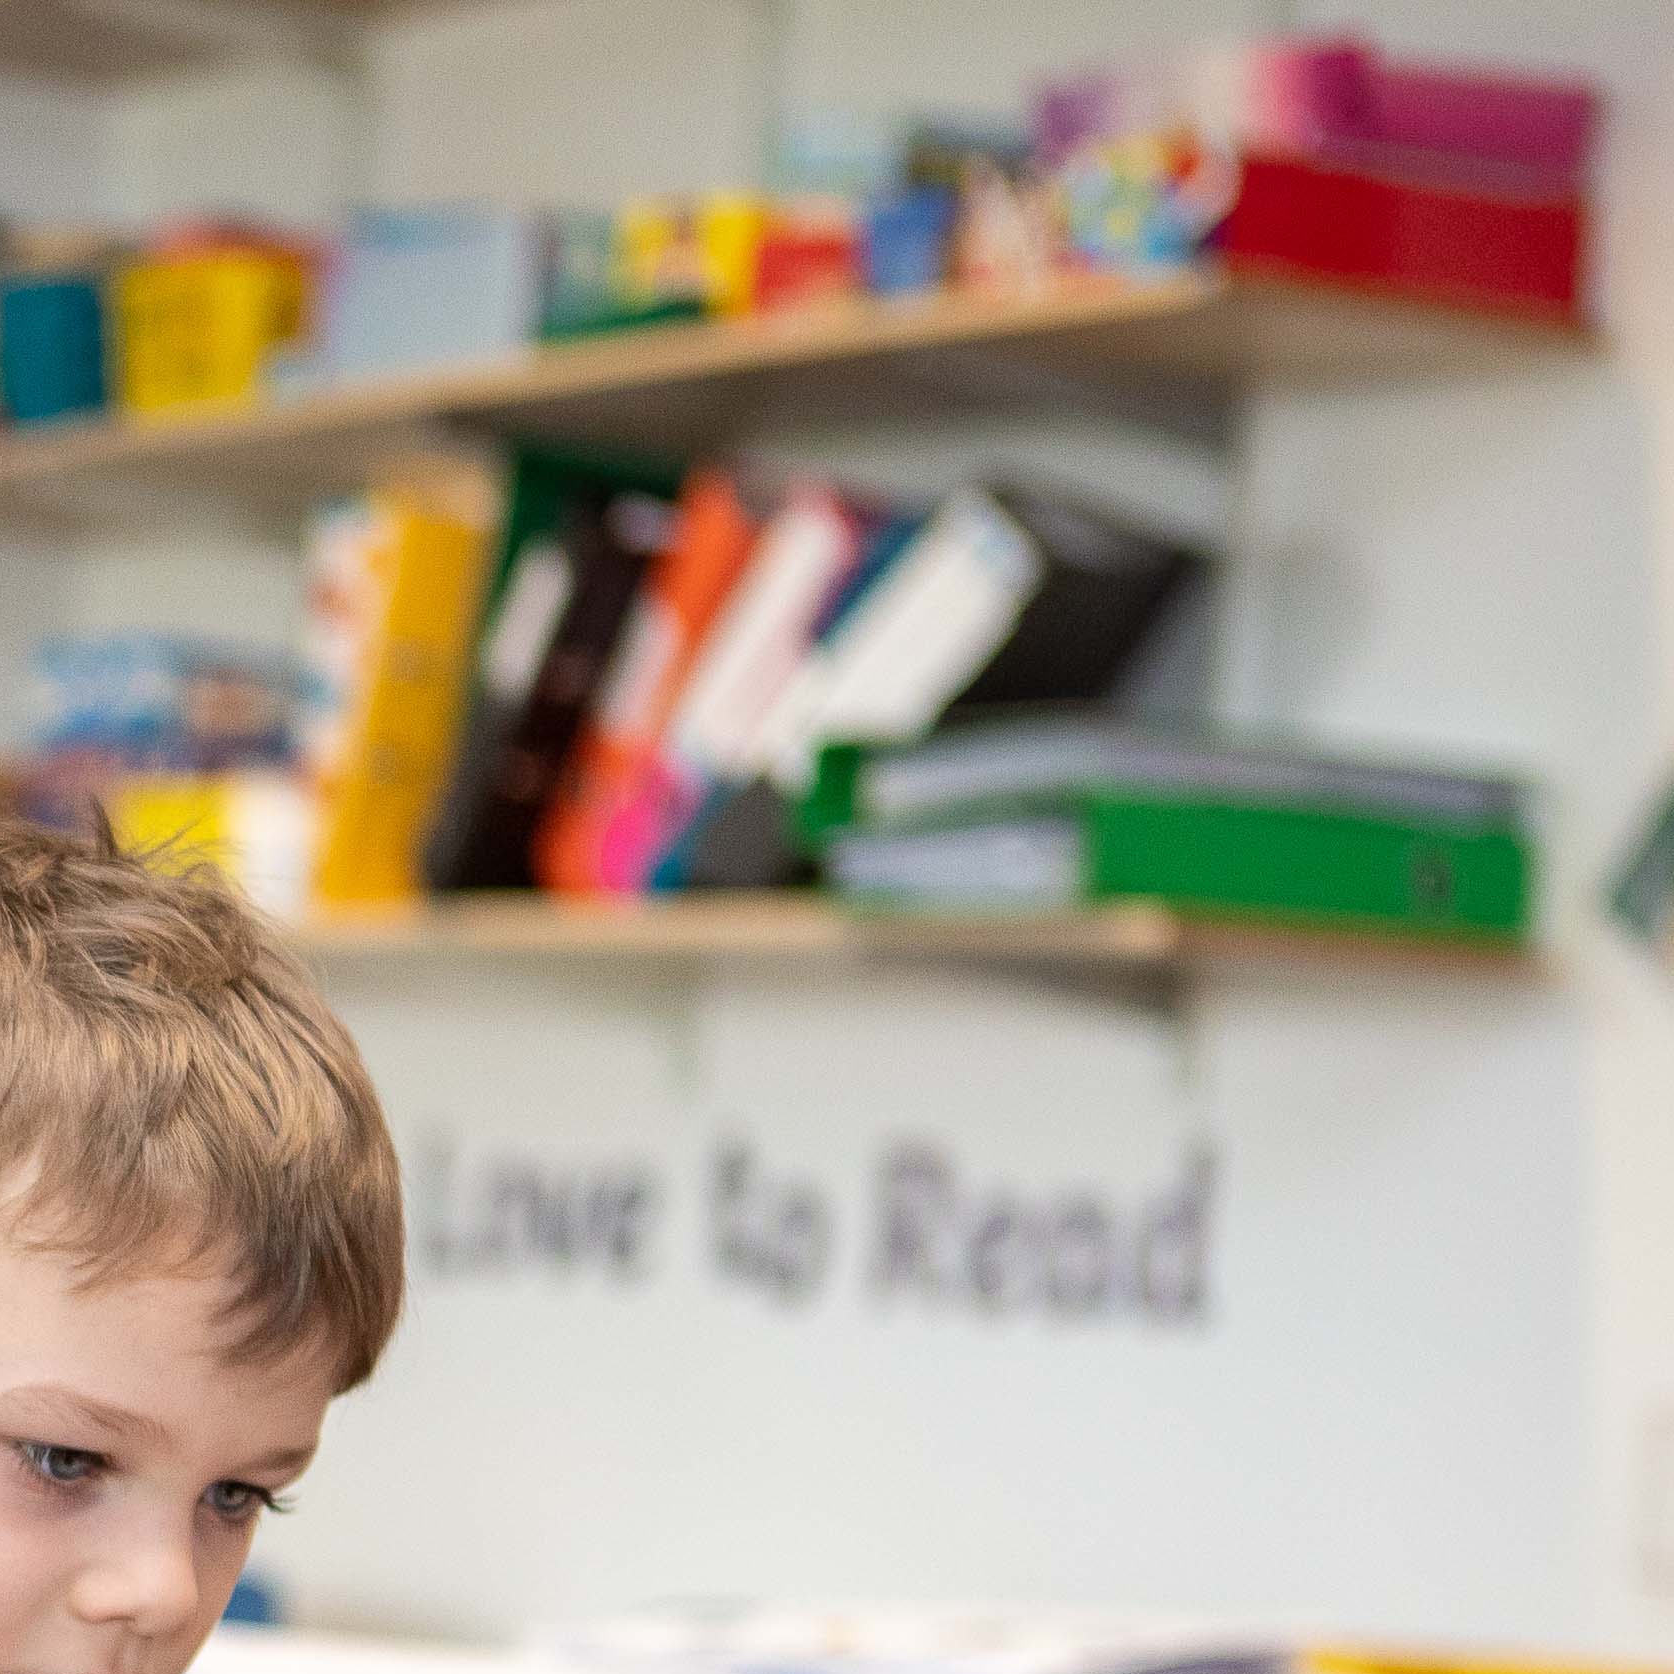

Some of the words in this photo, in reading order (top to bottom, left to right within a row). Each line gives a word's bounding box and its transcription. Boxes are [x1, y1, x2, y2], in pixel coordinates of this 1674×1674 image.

[415, 1122, 658, 1280] Love
[706, 1124, 824, 1306] to
[871, 1134, 1218, 1328] Read
